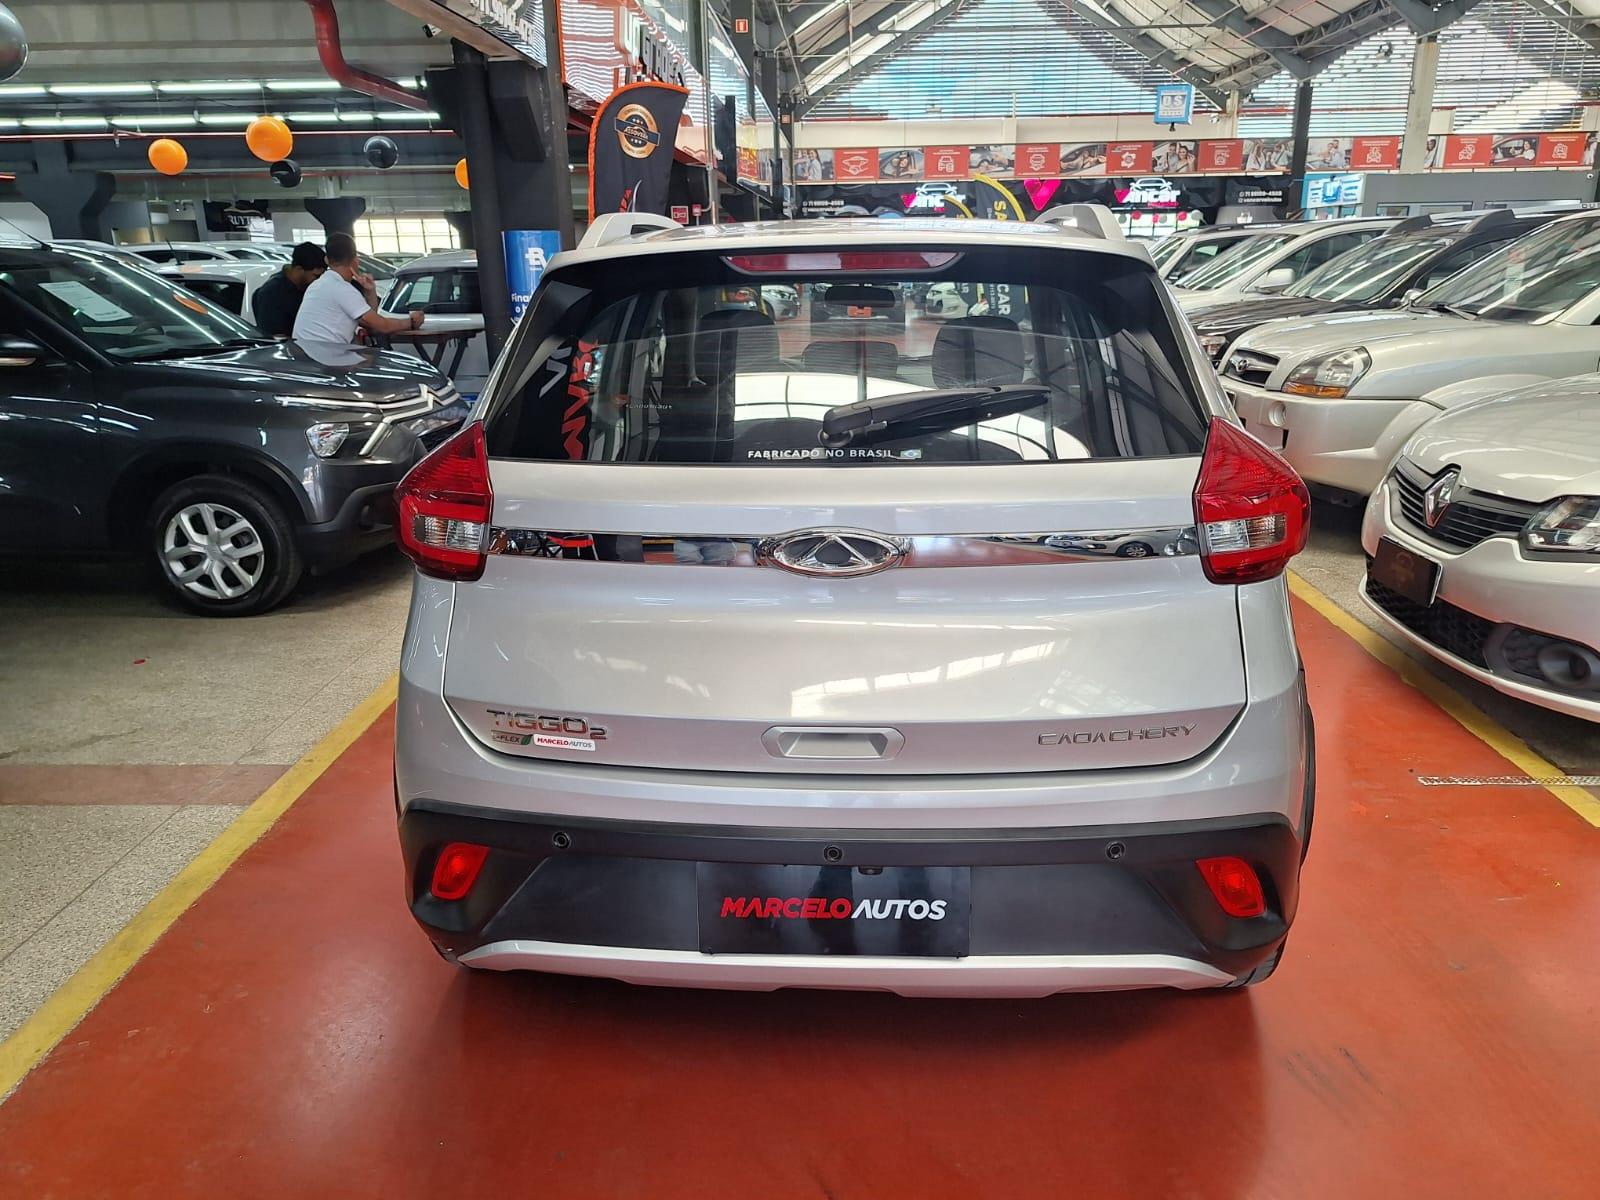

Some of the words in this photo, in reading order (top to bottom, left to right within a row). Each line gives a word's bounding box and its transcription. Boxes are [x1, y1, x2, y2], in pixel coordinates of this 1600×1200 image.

[747, 449, 820, 459] FABRICADO
[825, 449, 845, 458] NO
[849, 449, 893, 459] BRASIL
